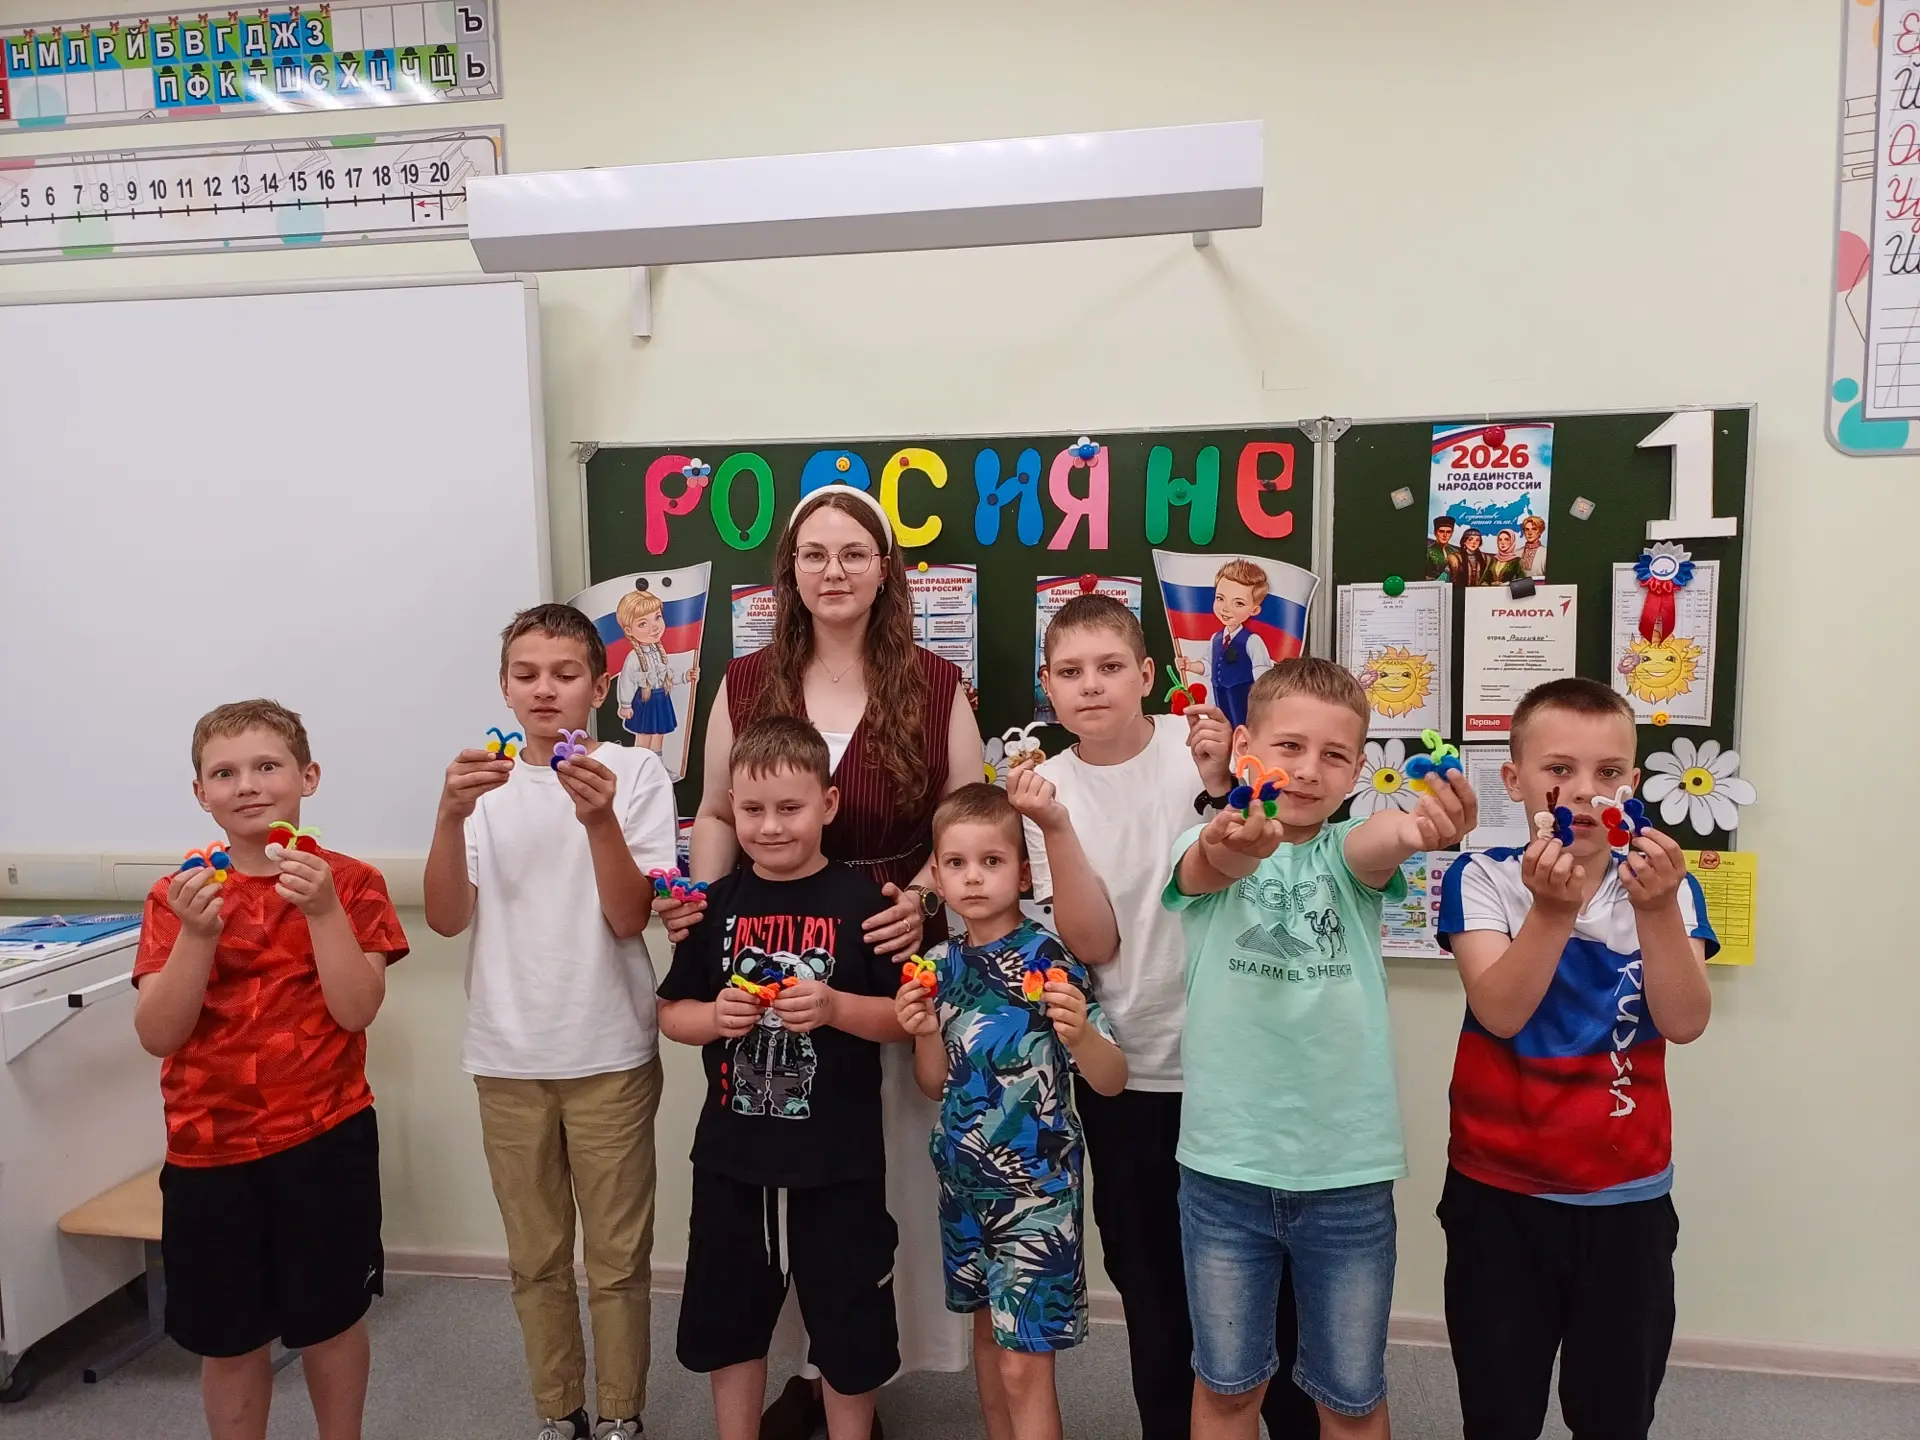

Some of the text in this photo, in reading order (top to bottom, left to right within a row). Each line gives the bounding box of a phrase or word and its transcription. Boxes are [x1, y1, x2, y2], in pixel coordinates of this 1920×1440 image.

[11, 7, 484, 70] Н М Л Р Й Б В Г Д Ж З Ъ
[159, 53, 486, 102] П Ф К Т Ш С Х Ц Ч Щ Ь
[20, 161, 450, 207] 5 6 7 8 9 10 11 12 13 14 15 16 17 18 19 20
[1451, 444, 1529, 469] 2026
[1438, 481, 1541, 491] НАРОДОВ РОССИИ
[1447, 472, 1533, 482] ГОД ЕДИНСТВА
[1636, 410, 1737, 540] 1
[1491, 609, 1554, 617] ГРАМОТА
[1469, 718, 1500, 727] Первые
[1229, 958, 1352, 981] SHARM EL SHEIKH
